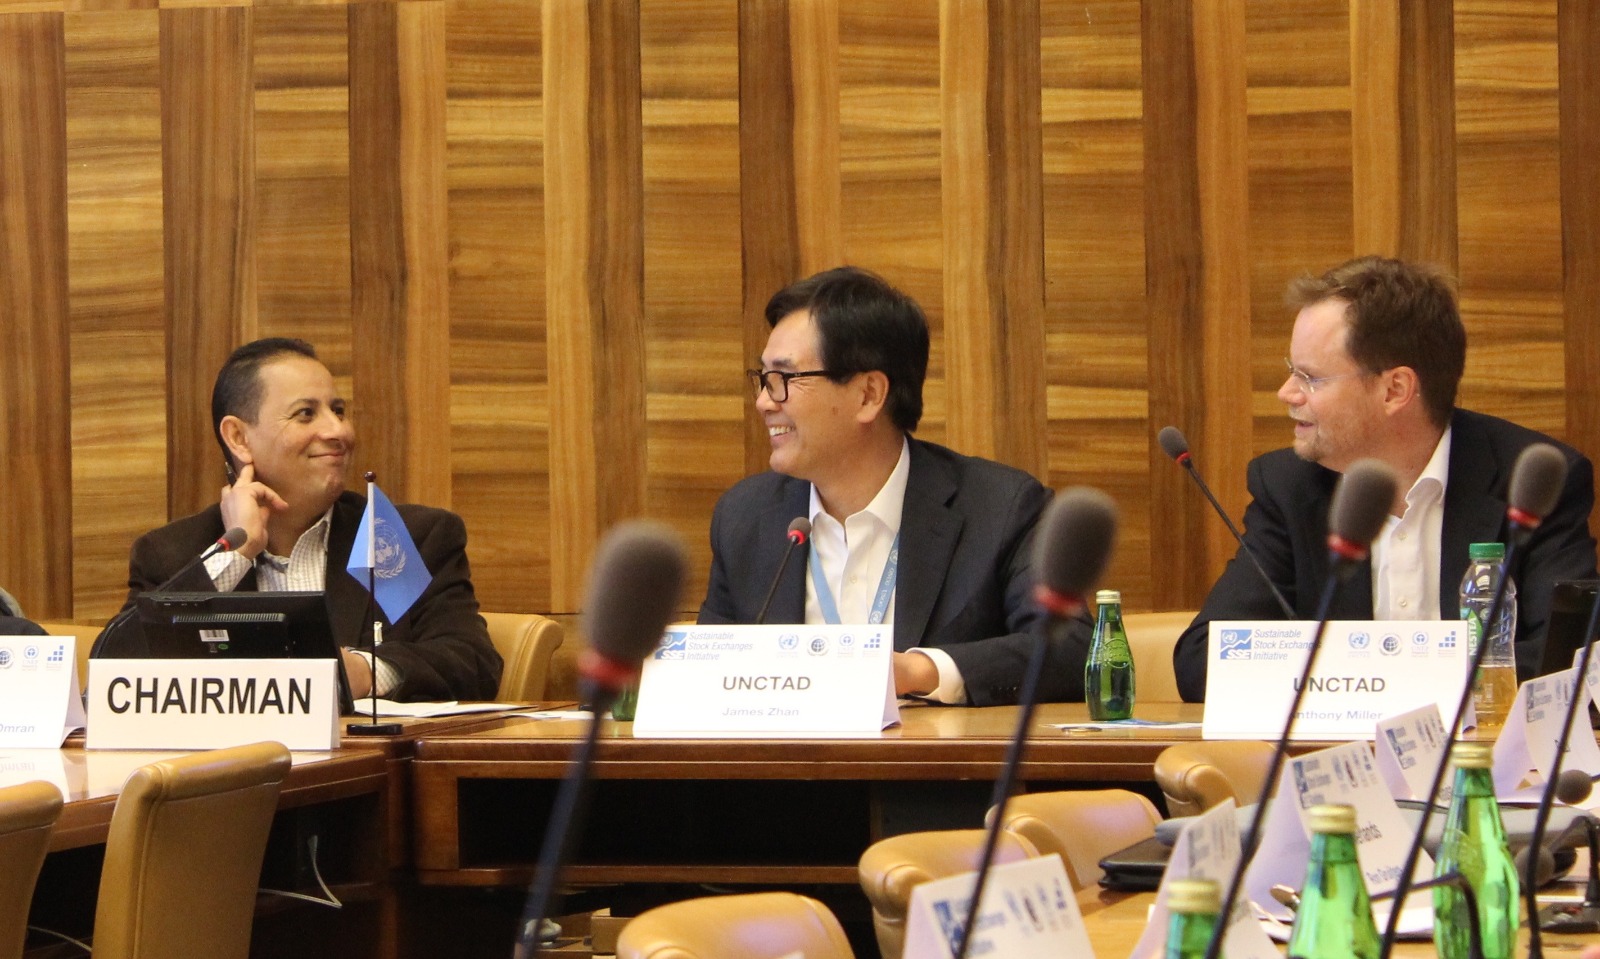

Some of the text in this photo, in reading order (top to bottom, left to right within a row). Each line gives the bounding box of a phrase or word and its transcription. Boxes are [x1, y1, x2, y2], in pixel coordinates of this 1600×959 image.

[689, 632, 734, 640] Sustainable
[1254, 629, 1302, 638] Sustainable
[1468, 617, 1478, 656] NESTEA
[688, 642, 753, 651] Stock Exchanges
[1253, 641, 1276, 649] Stock
[661, 649, 685, 660] SSE
[687, 652, 720, 660] Initiative
[1226, 649, 1251, 660] SSE
[1253, 652, 1288, 660] Initiative
[722, 676, 811, 691] UNCTAD
[107, 677, 312, 714] CHAIRMAN
[722, 707, 799, 717] James Zhan
[1292, 710, 1383, 720] nthony Miller
